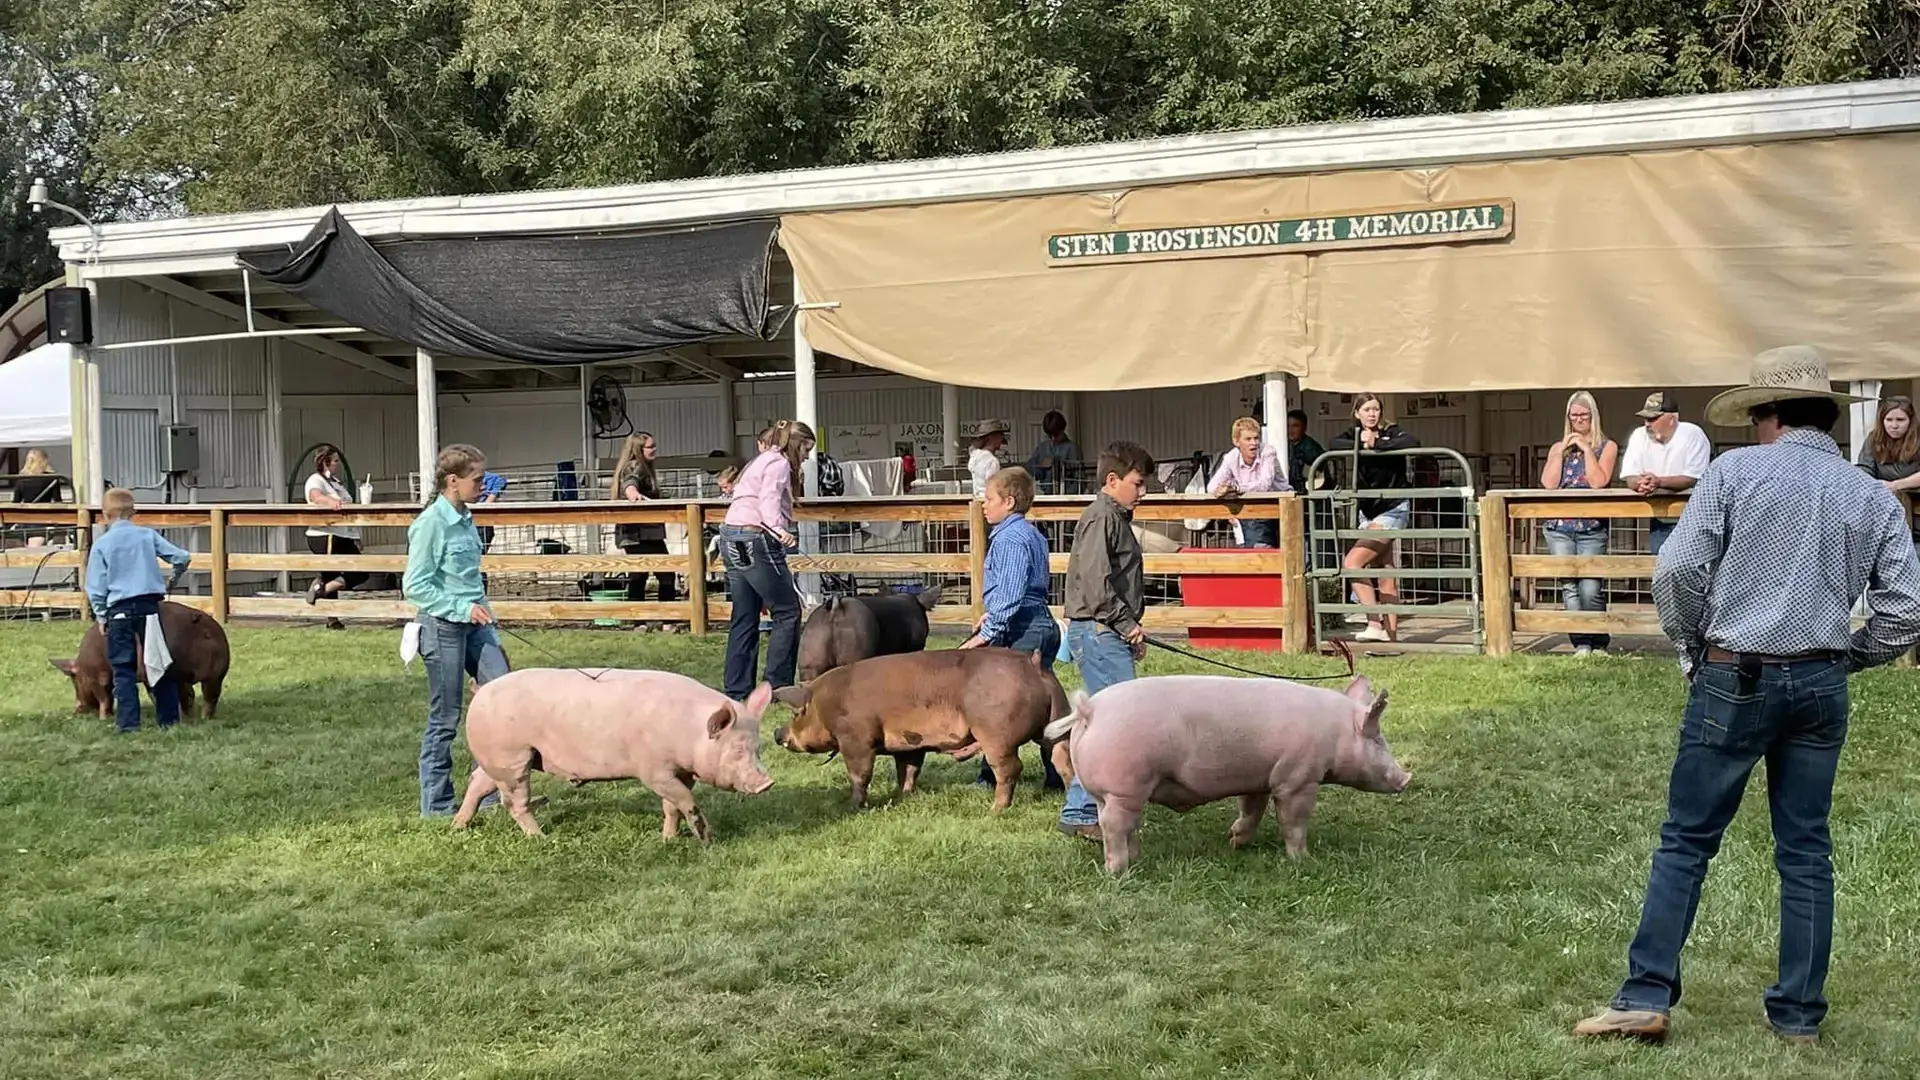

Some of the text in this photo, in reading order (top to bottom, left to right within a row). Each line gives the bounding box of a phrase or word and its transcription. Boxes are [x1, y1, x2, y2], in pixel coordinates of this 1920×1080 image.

[1056, 233, 1116, 257] STEN
[1126, 222, 1280, 253] FROSTENSON
[1347, 207, 1496, 239] MEMORIAL
